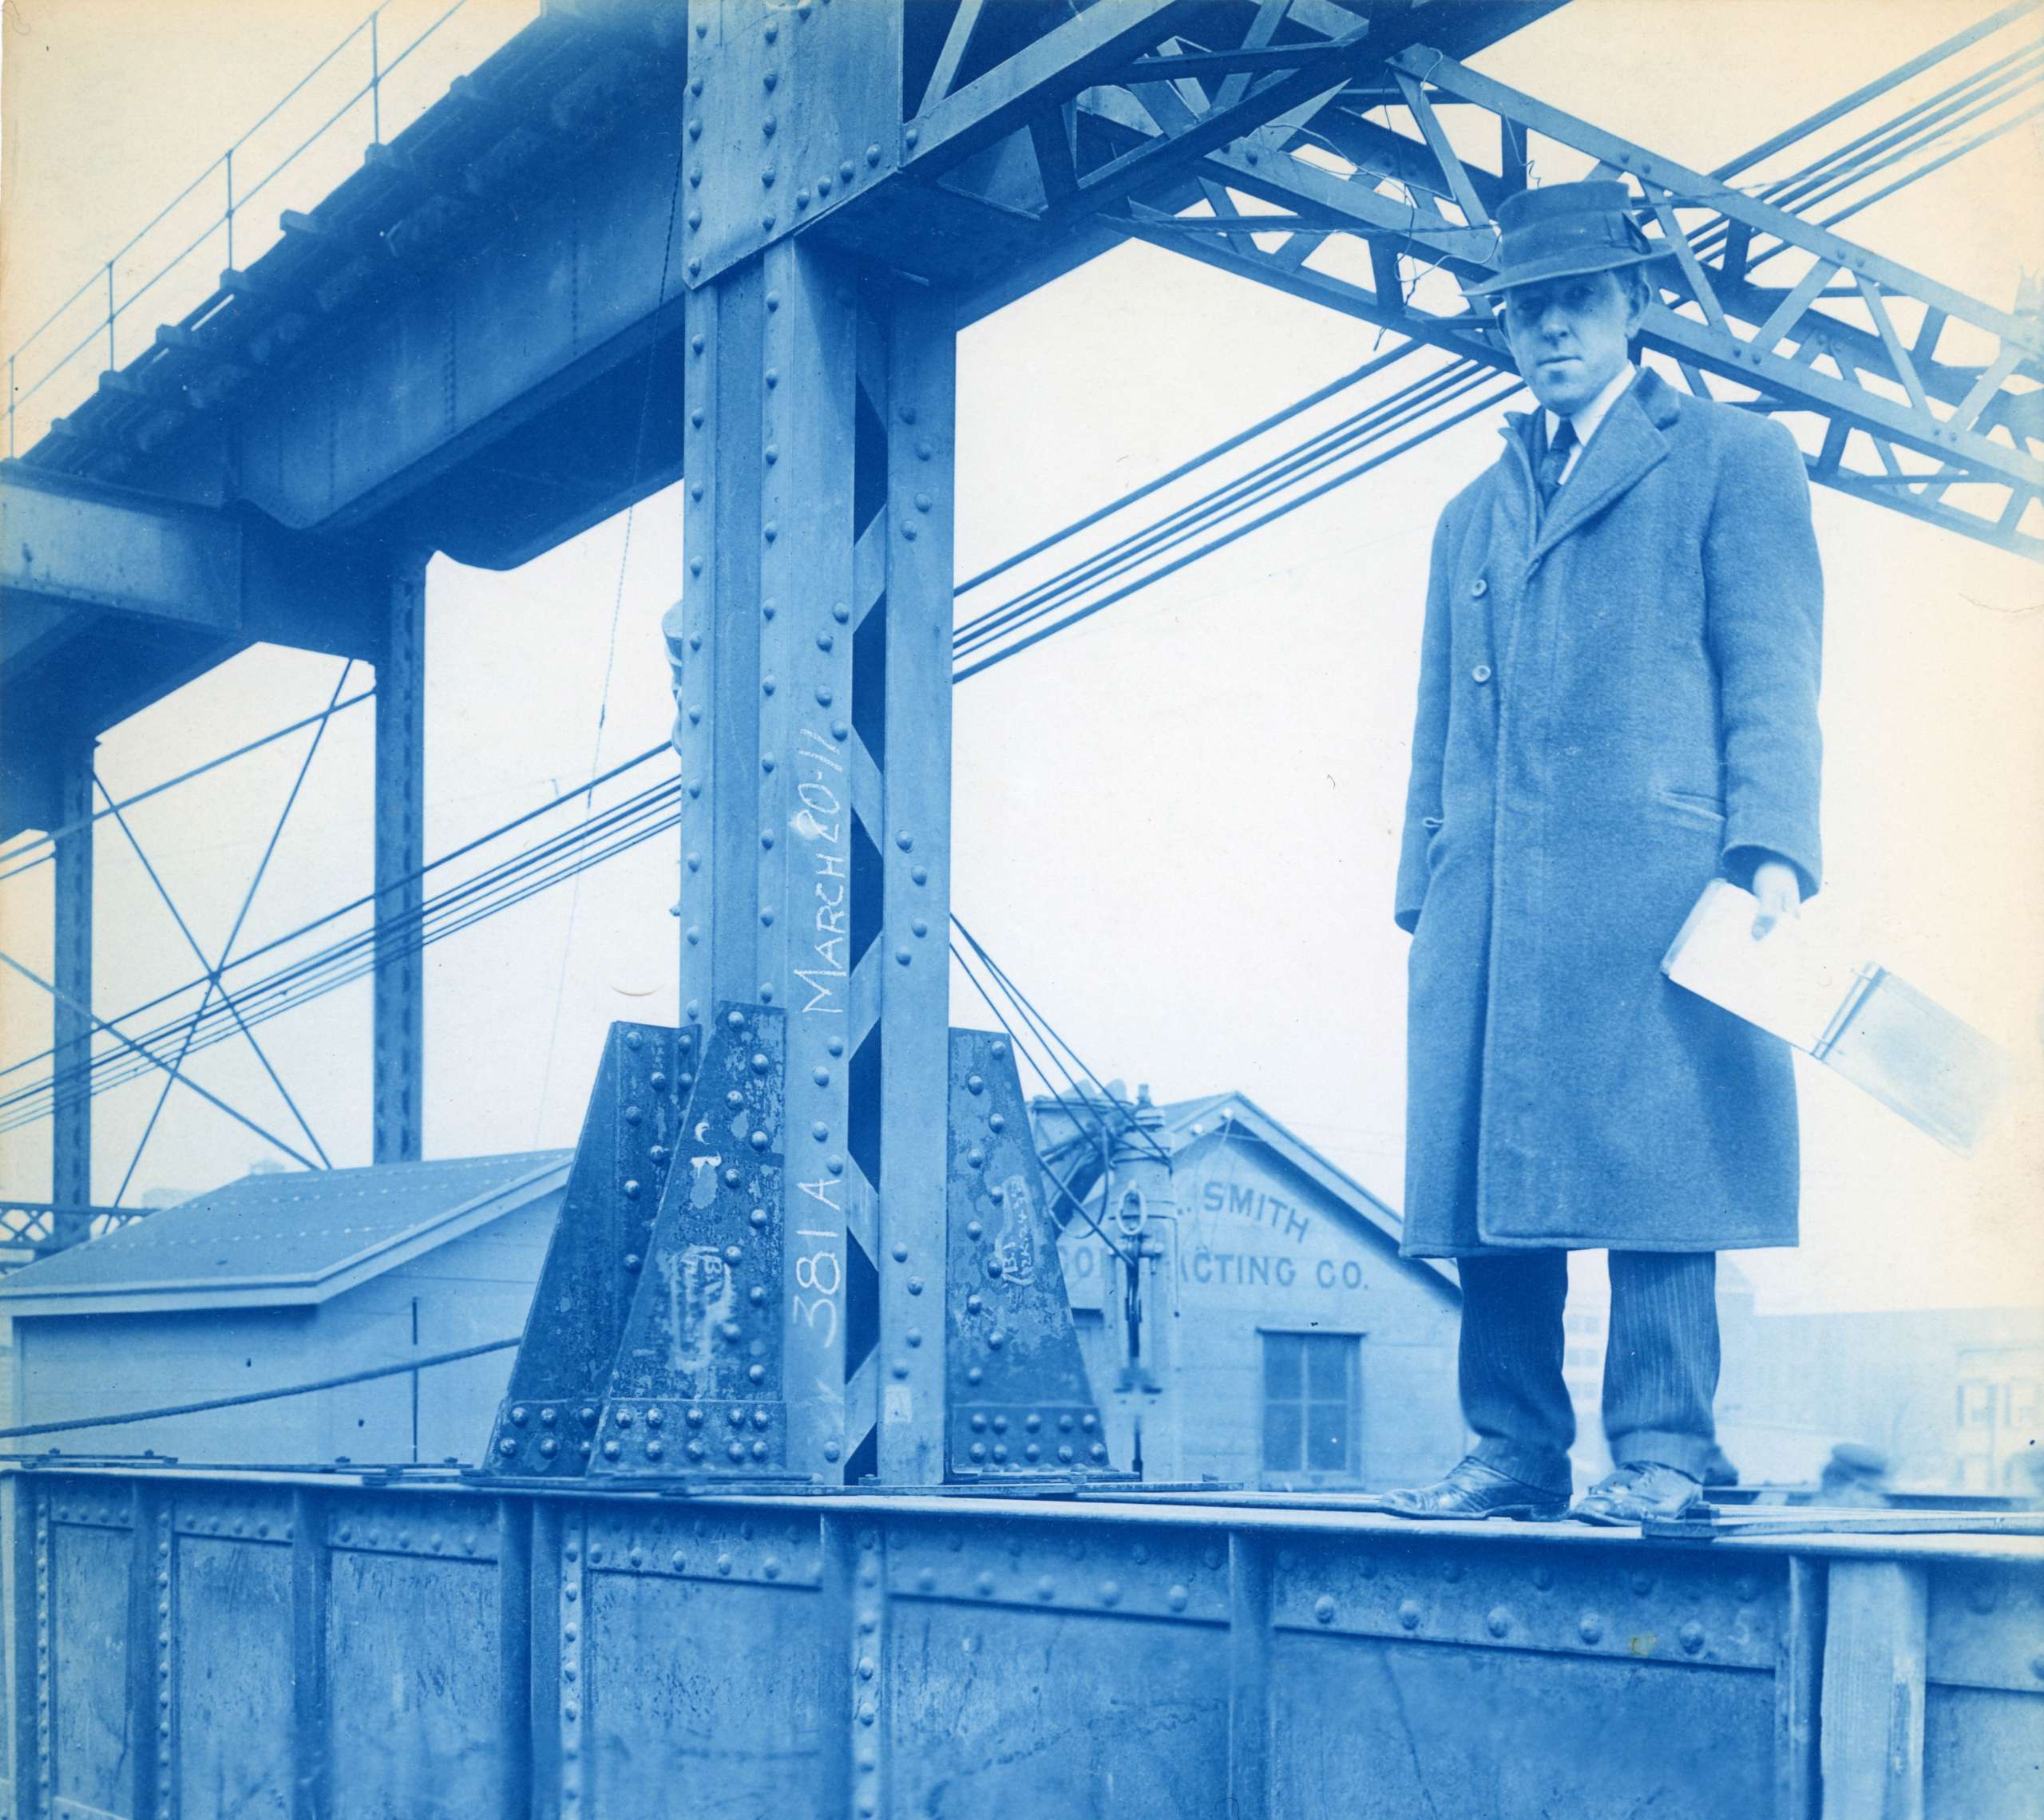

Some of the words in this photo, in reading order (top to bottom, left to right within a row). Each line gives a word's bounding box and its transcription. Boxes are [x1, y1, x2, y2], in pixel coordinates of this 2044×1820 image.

[793, 853, 847, 1015] MARCH
[1203, 1181, 1309, 1244] SMITH
[1316, 1259, 1369, 1291] CO.
